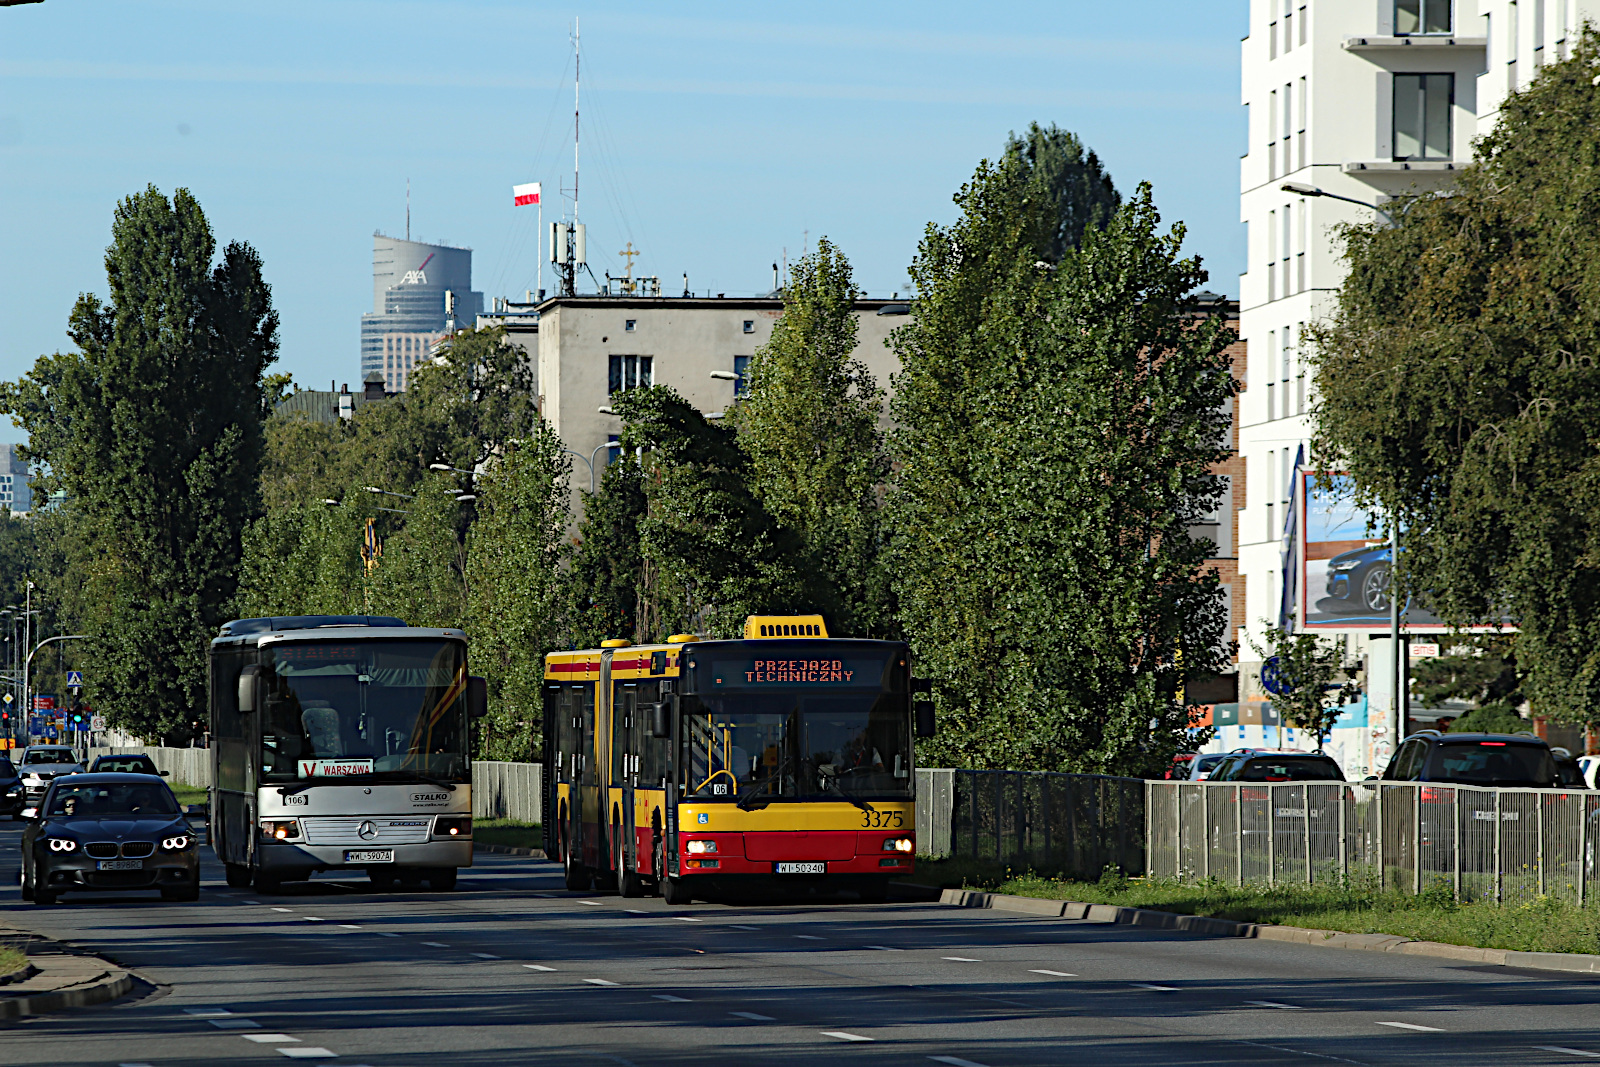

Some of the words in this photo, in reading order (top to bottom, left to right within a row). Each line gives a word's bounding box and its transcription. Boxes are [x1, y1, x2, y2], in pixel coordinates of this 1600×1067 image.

[400, 270, 428, 284] AXA
[281, 648, 356, 659] STALKO
[1413, 645, 1436, 655] ams
[754, 660, 842, 671] PRZEJAZD
[744, 671, 854, 682] TECHNICZNY
[303, 763, 317, 777] V
[323, 765, 370, 775] WARSZAWA
[715, 784, 726, 794] 06
[288, 796, 303, 804] 106
[414, 793, 448, 801] STALKO
[861, 811, 904, 828] 3375
[350, 852, 365, 861] WWL
[367, 851, 391, 861] 5907A
[102, 861, 113, 869] WE
[780, 864, 791, 873] WI
[795, 863, 823, 872] 50340
